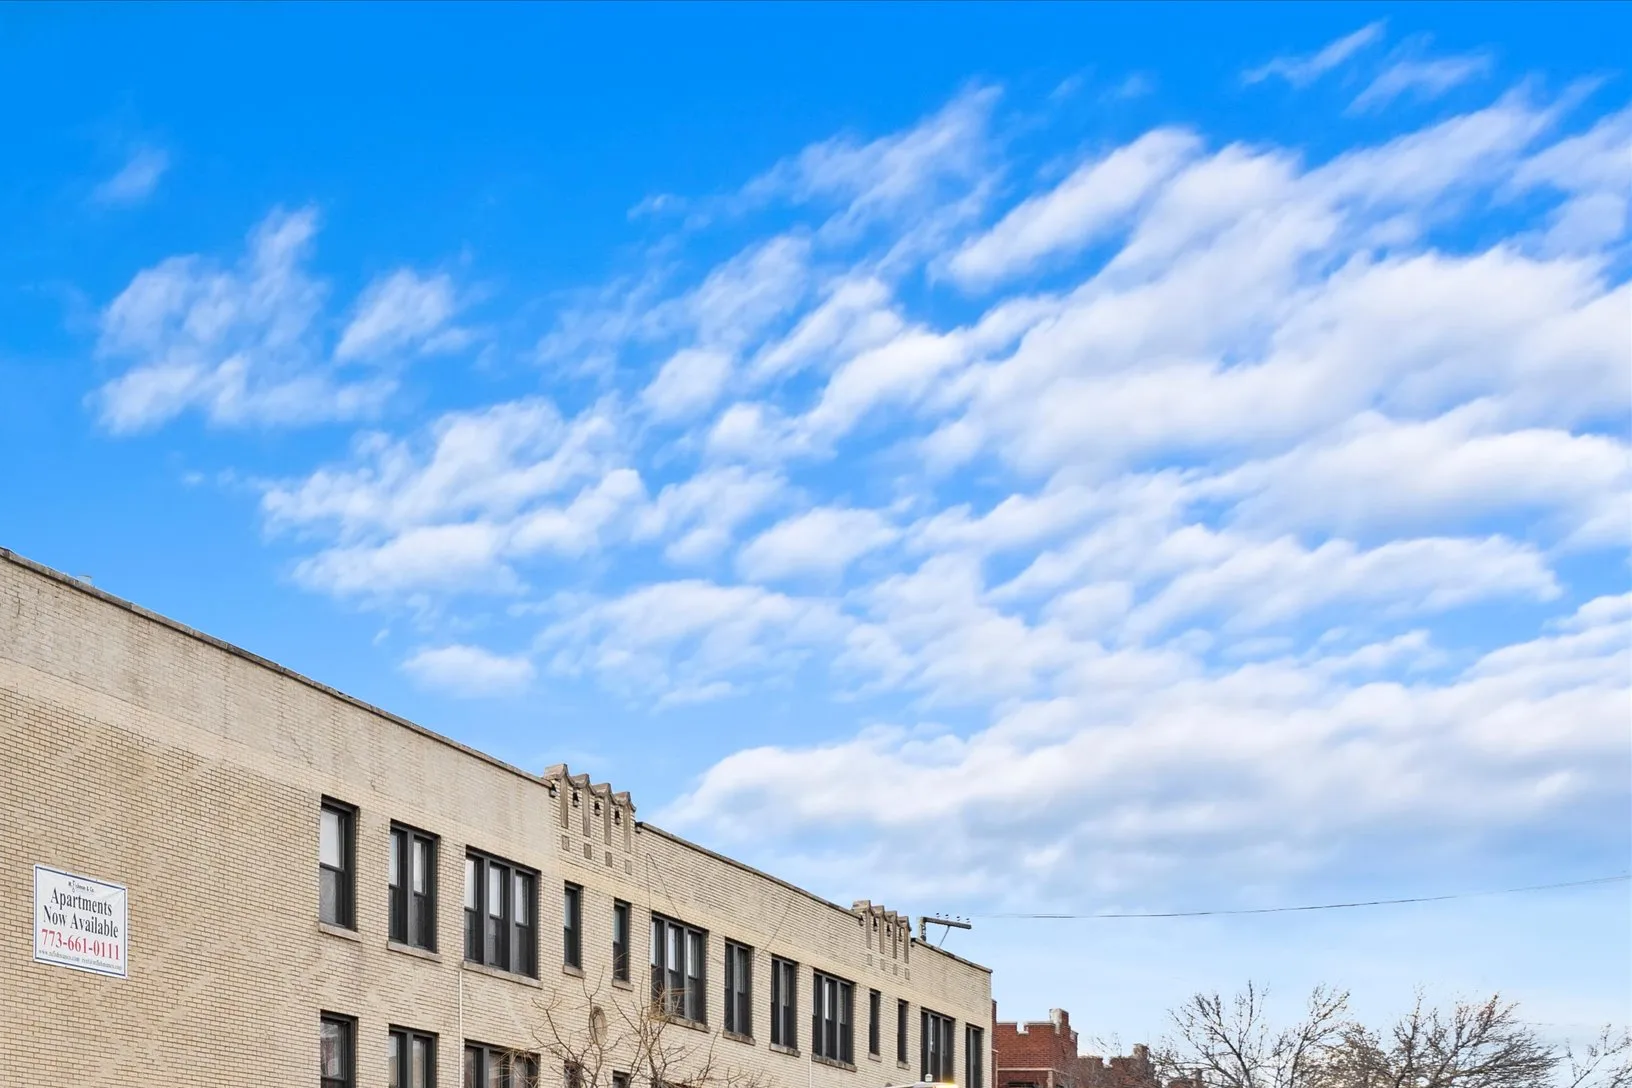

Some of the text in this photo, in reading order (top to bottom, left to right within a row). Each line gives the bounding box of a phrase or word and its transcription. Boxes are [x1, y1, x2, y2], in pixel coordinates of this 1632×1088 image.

[51, 887, 112, 916] Apartments
[43, 905, 119, 938] Now Available
[41, 928, 119, 960] 773-661-0111
